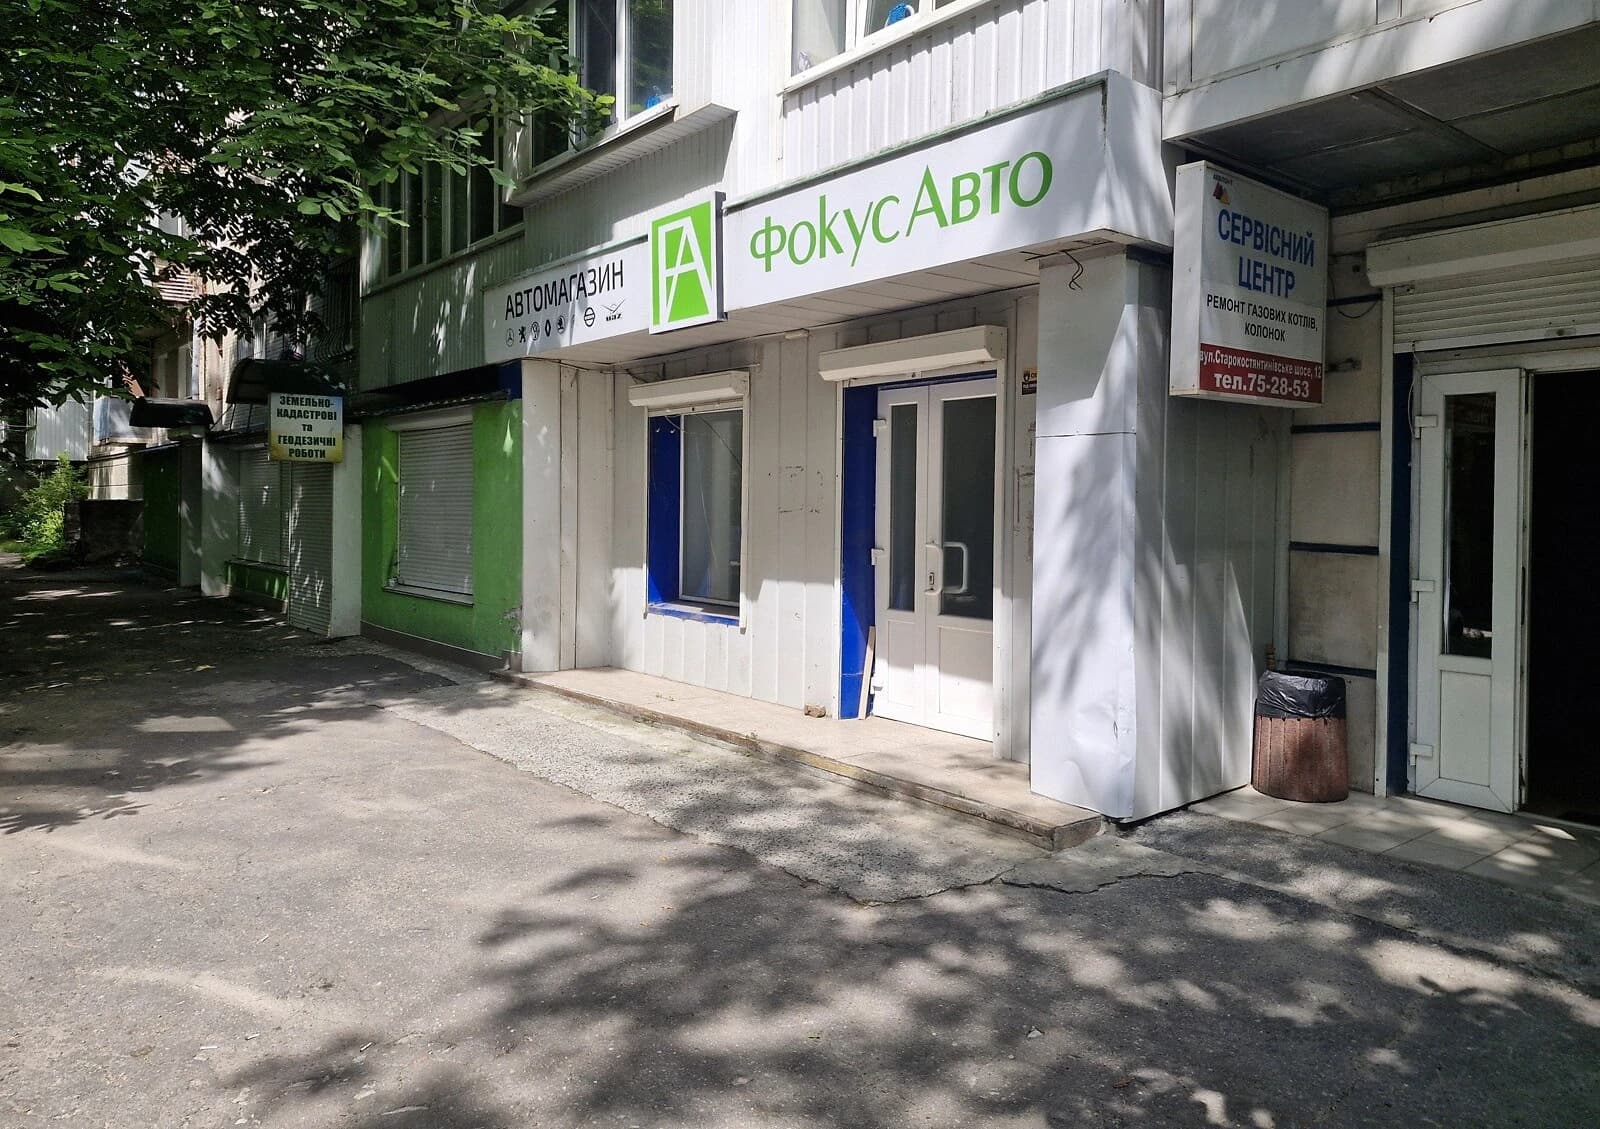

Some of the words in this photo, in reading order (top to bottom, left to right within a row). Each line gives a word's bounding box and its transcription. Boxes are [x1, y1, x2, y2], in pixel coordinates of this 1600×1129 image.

[1218, 209, 1314, 267] СЕРВІСНИЙ
[1238, 256, 1295, 298] ЦЕНТР
[505, 259, 624, 320] АВТОМАГАЗИН
[1207, 294, 1245, 314] РЕМОНТ
[1247, 303, 1286, 323] ГАЗОВИХ
[1288, 312, 1318, 332] КОТЛІВ,
[1245, 322, 1286, 342] КОЛОНОК
[1315, 365, 1322, 378] 12
[1213, 373, 1310, 398] тел.75-28-53
[280, 396, 335, 408] ЗЕМЕЛЬНО-
[277, 408, 337, 420] КАДАСТРОВІ
[302, 424, 313, 432] та
[278, 435, 336, 446] ГЕОДЕЗИЧНІ
[289, 448, 326, 458] РОБОТИ
